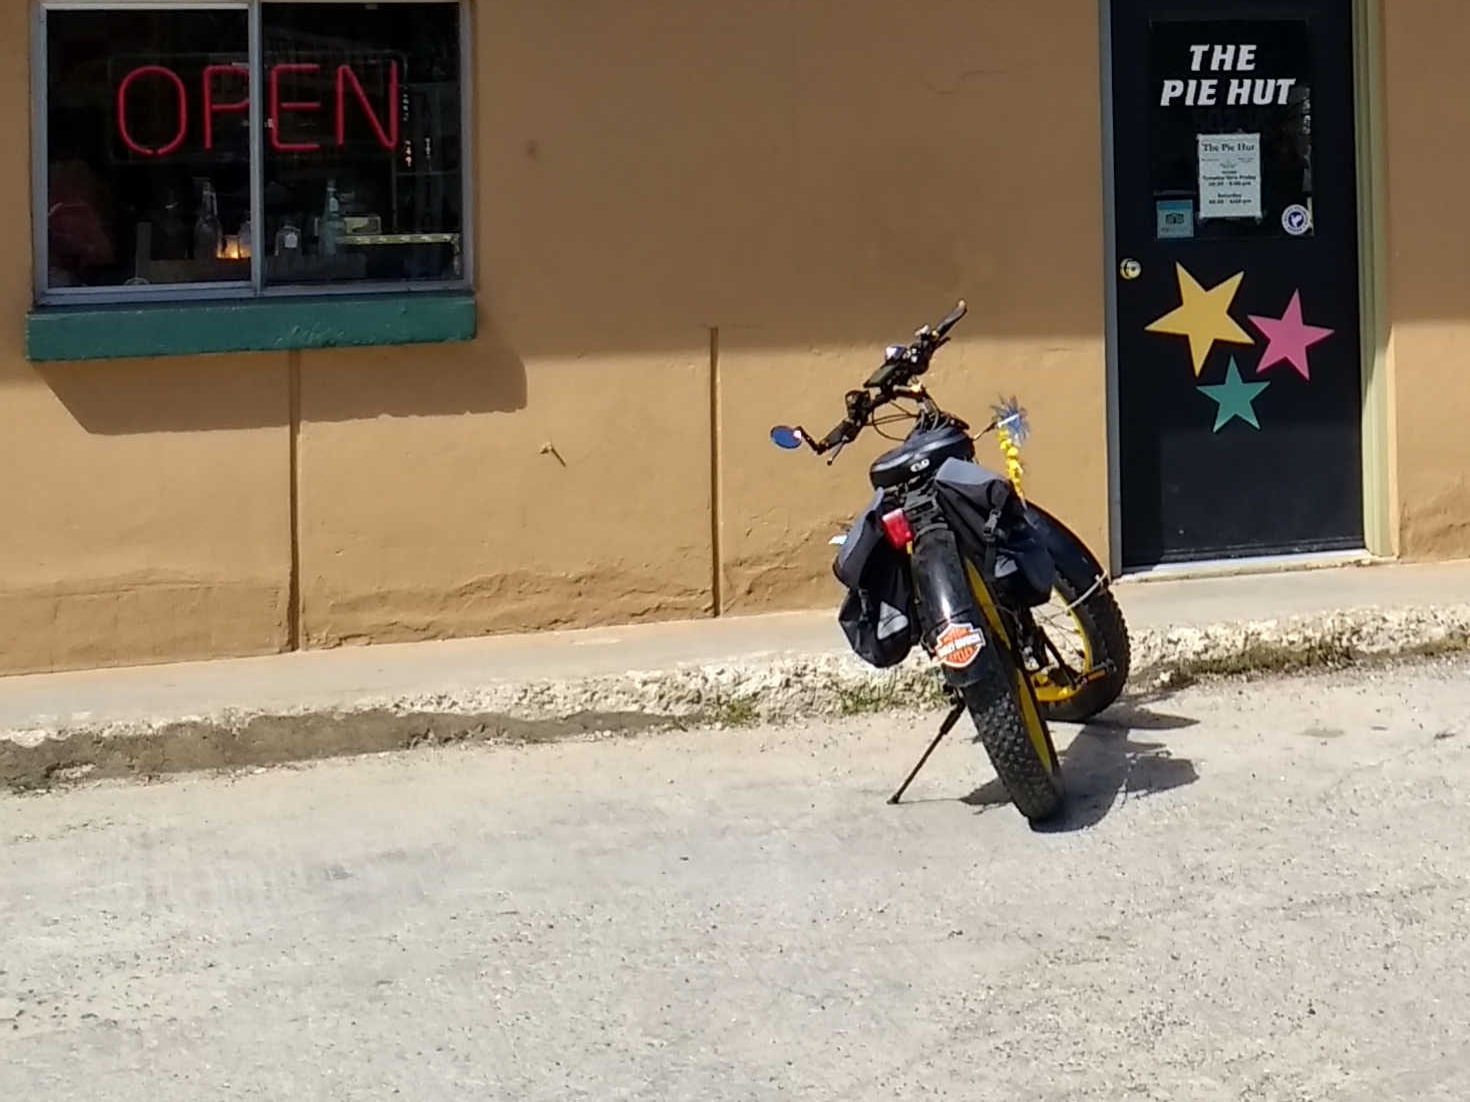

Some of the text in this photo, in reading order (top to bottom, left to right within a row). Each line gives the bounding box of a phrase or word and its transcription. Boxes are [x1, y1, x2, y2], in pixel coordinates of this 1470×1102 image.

[1190, 44, 1257, 71] THE
[1160, 78, 1296, 106] PIE HUT
[118, 62, 398, 155] OPEN
